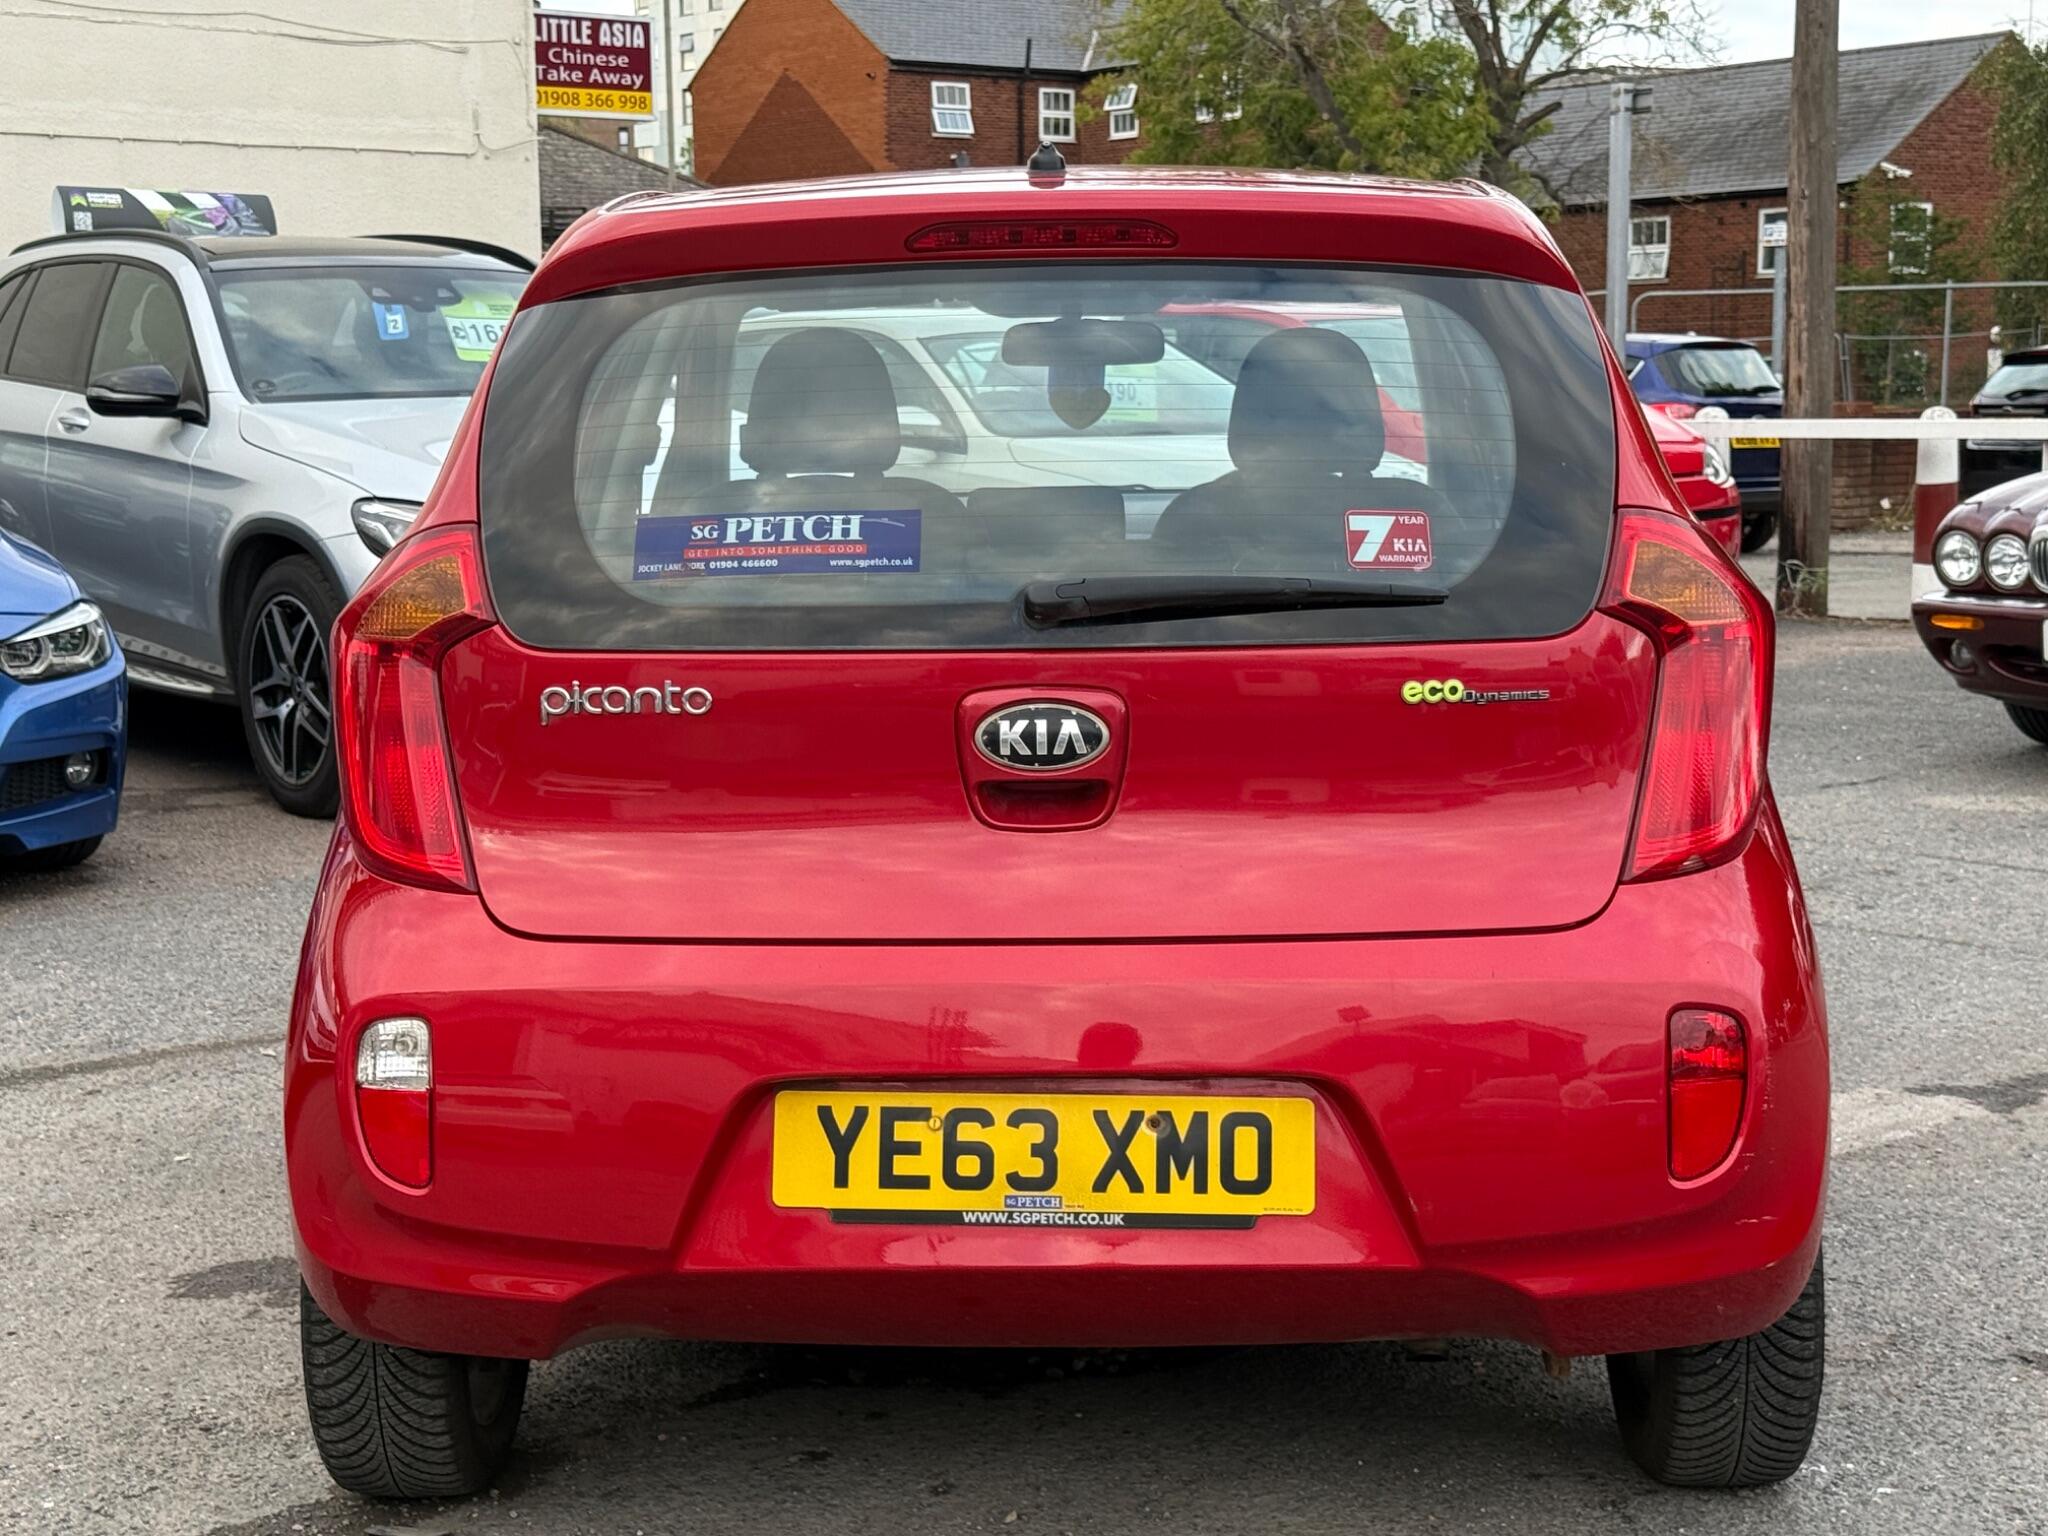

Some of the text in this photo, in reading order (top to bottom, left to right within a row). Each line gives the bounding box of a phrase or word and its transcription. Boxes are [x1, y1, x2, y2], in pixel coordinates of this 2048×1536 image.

[599, 21, 645, 49] ASIA
[548, 47, 629, 67] Chinese
[536, 65, 643, 89] Take Away
[585, 92, 614, 109] 366
[619, 94, 648, 110] 998
[452, 323, 506, 343] £16
[691, 515, 864, 543] SG PETCH
[1348, 515, 1424, 562] 7 YEAR
[688, 544, 864, 558] GET INTO SOMETHING GOOD
[1392, 537, 1428, 552] KIA
[709, 560, 738, 569] 01904
[829, 557, 913, 568] www.sgpetch.co.uk
[1378, 554, 1428, 563] WARRANTY
[540, 680, 712, 725] picanto
[998, 718, 1088, 756] KIA
[816, 1104, 1273, 1196] YE63 XMO
[1018, 1197, 1060, 1208] PETCH
[963, 1211, 1125, 1226] WWW.SGPETCH.CO.UK
